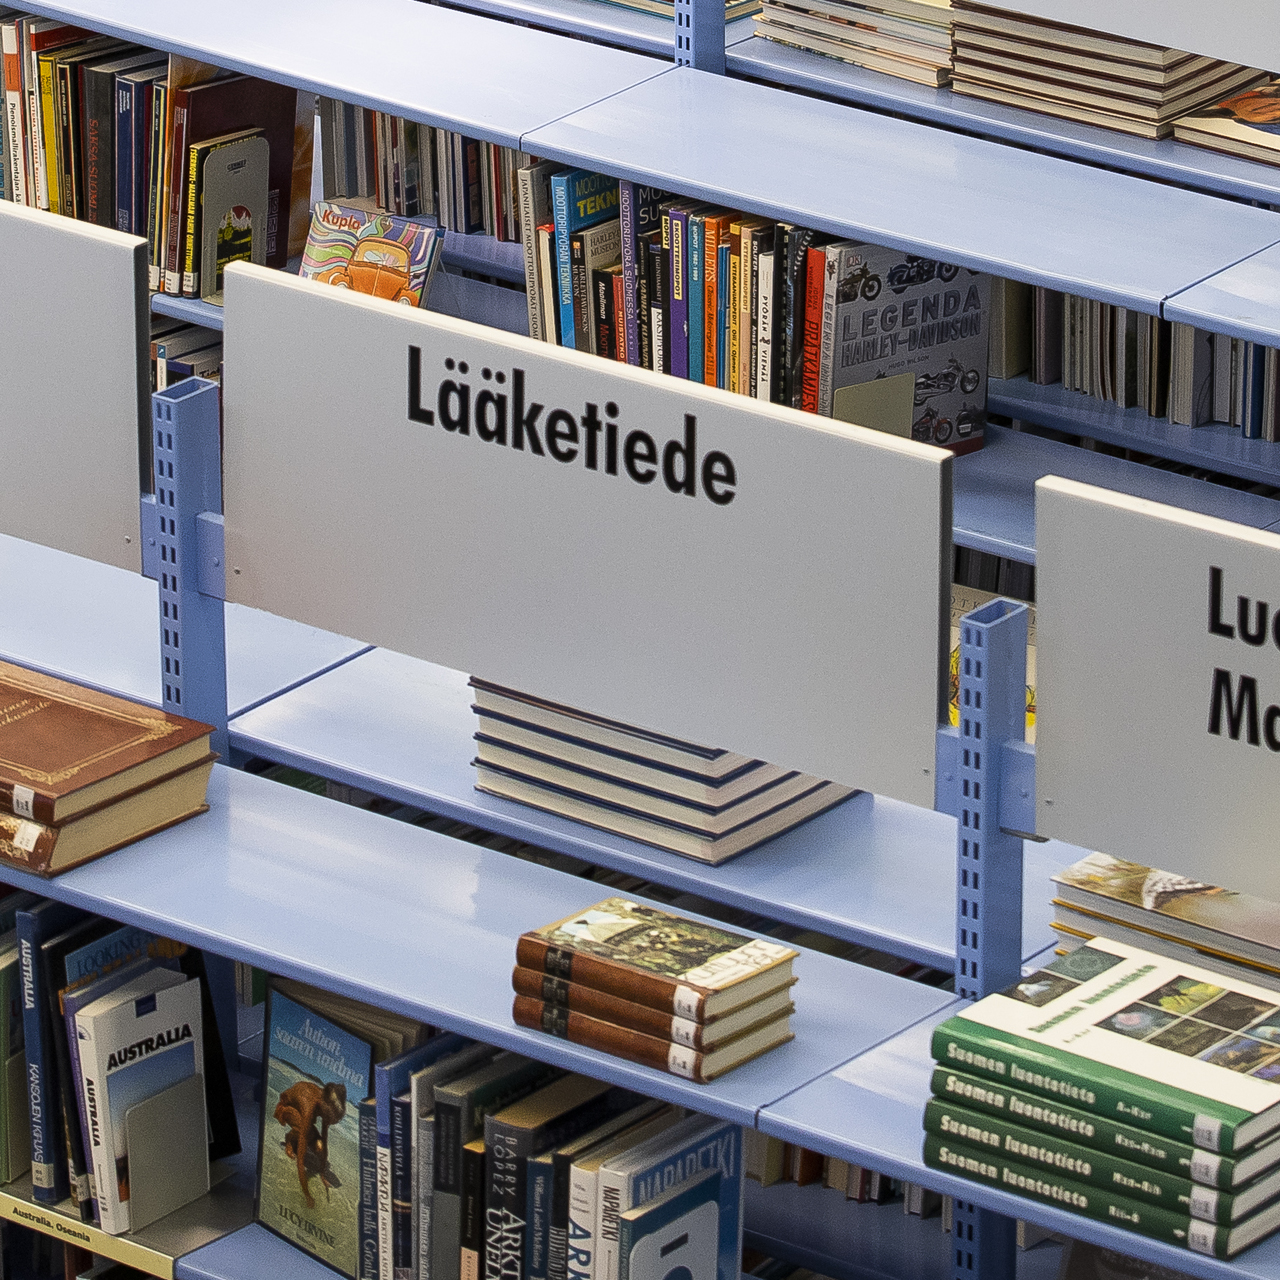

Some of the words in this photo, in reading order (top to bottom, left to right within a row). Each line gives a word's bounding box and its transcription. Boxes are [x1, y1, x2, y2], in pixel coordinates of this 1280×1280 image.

[321, 209, 361, 231] Kupla
[561, 262, 572, 306] TEKNIIKKA
[673, 221, 681, 298] SKOOTTERIMOPOT
[598, 281, 606, 320] Maailman
[624, 270, 634, 320] SUOMESSA
[842, 285, 982, 342] LEGENDA
[841, 318, 982, 368] HARLEY-DAVIDSON
[408, 343, 738, 506] Lääketiede
[20, 938, 35, 1010] AUSTRALIA
[105, 1024, 193, 1072] AUSTRALIA
[946, 1041, 1006, 1074] Suomen
[1010, 1062, 1097, 1105] luontotieto
[29, 1063, 43, 1119] KANSOJEN
[85, 1077, 101, 1147] AUSTRALIA
[945, 1075, 1005, 1108] Suomen
[1009, 1095, 1095, 1137] luontotieto
[492, 1132, 505, 1196] LOPEZ
[503, 1135, 518, 1198] BARRY
[940, 1114, 1001, 1147] Suomen
[1004, 1134, 1092, 1176] luontotieto
[939, 1146, 998, 1179] Suomen
[1002, 1167, 1089, 1209] luontotieto
[55, 1222, 91, 1245] Oseania
